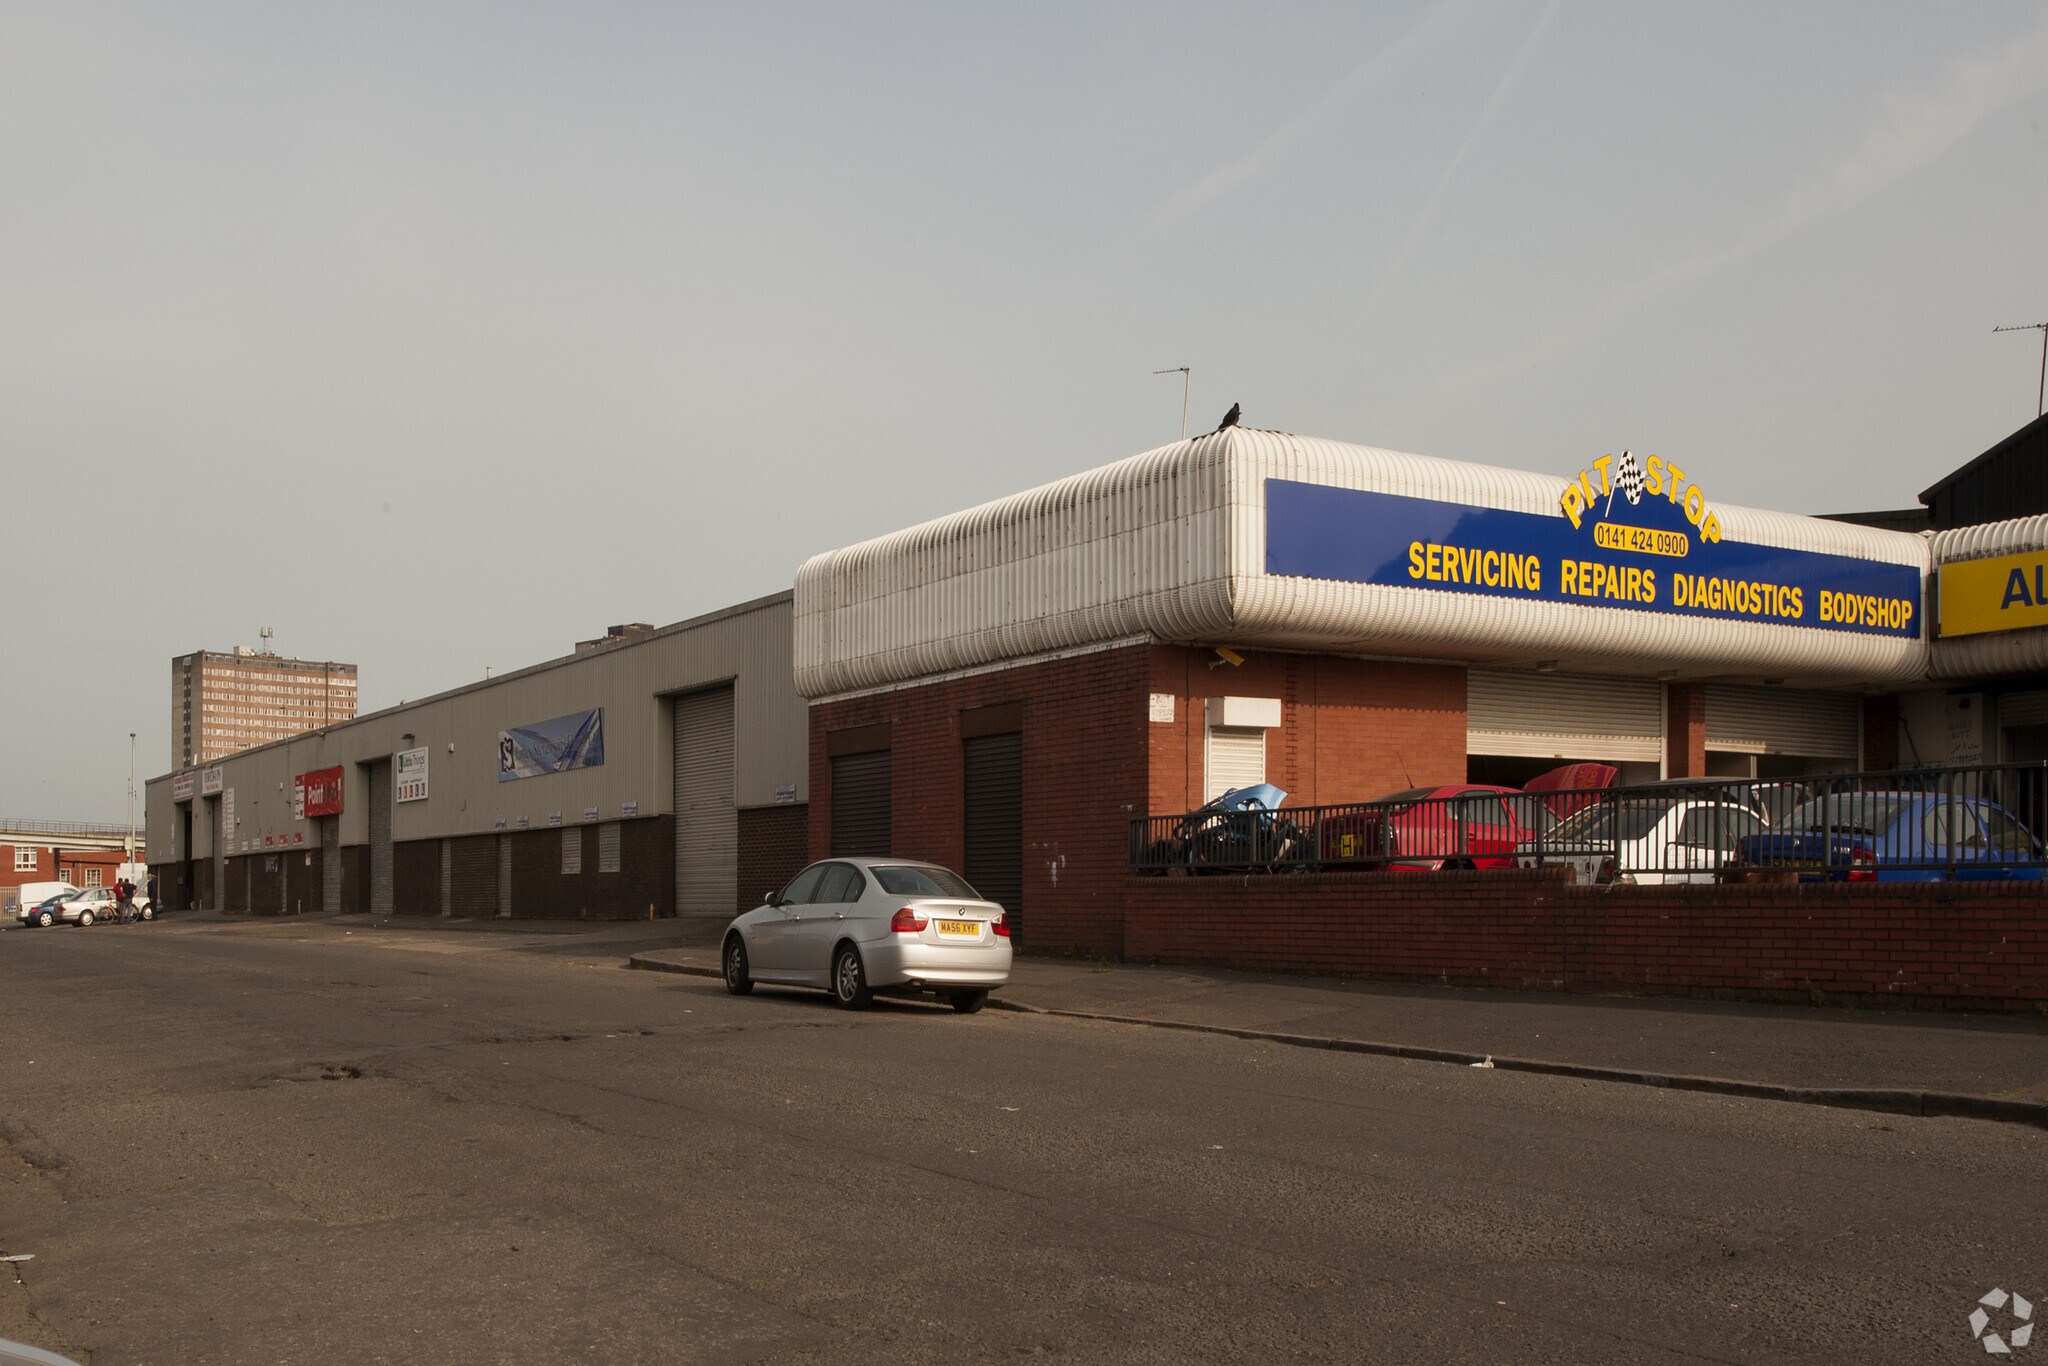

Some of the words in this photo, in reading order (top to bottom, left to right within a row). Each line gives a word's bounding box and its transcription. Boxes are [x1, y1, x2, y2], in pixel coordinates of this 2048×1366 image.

[1561, 454, 1612, 530] PIT
[1645, 455, 1721, 544] STOP
[1597, 525, 1626, 547] 0141
[1631, 531, 1653, 550] 424
[1657, 535, 1686, 555] 0900
[1408, 541, 1541, 591] SERVICING
[1561, 559, 1656, 603] REPAIRS
[1673, 573, 1803, 619] DIAGNOSTICS
[1819, 590, 1913, 630] BODYSHOP
[941, 922, 960, 933] MA56
